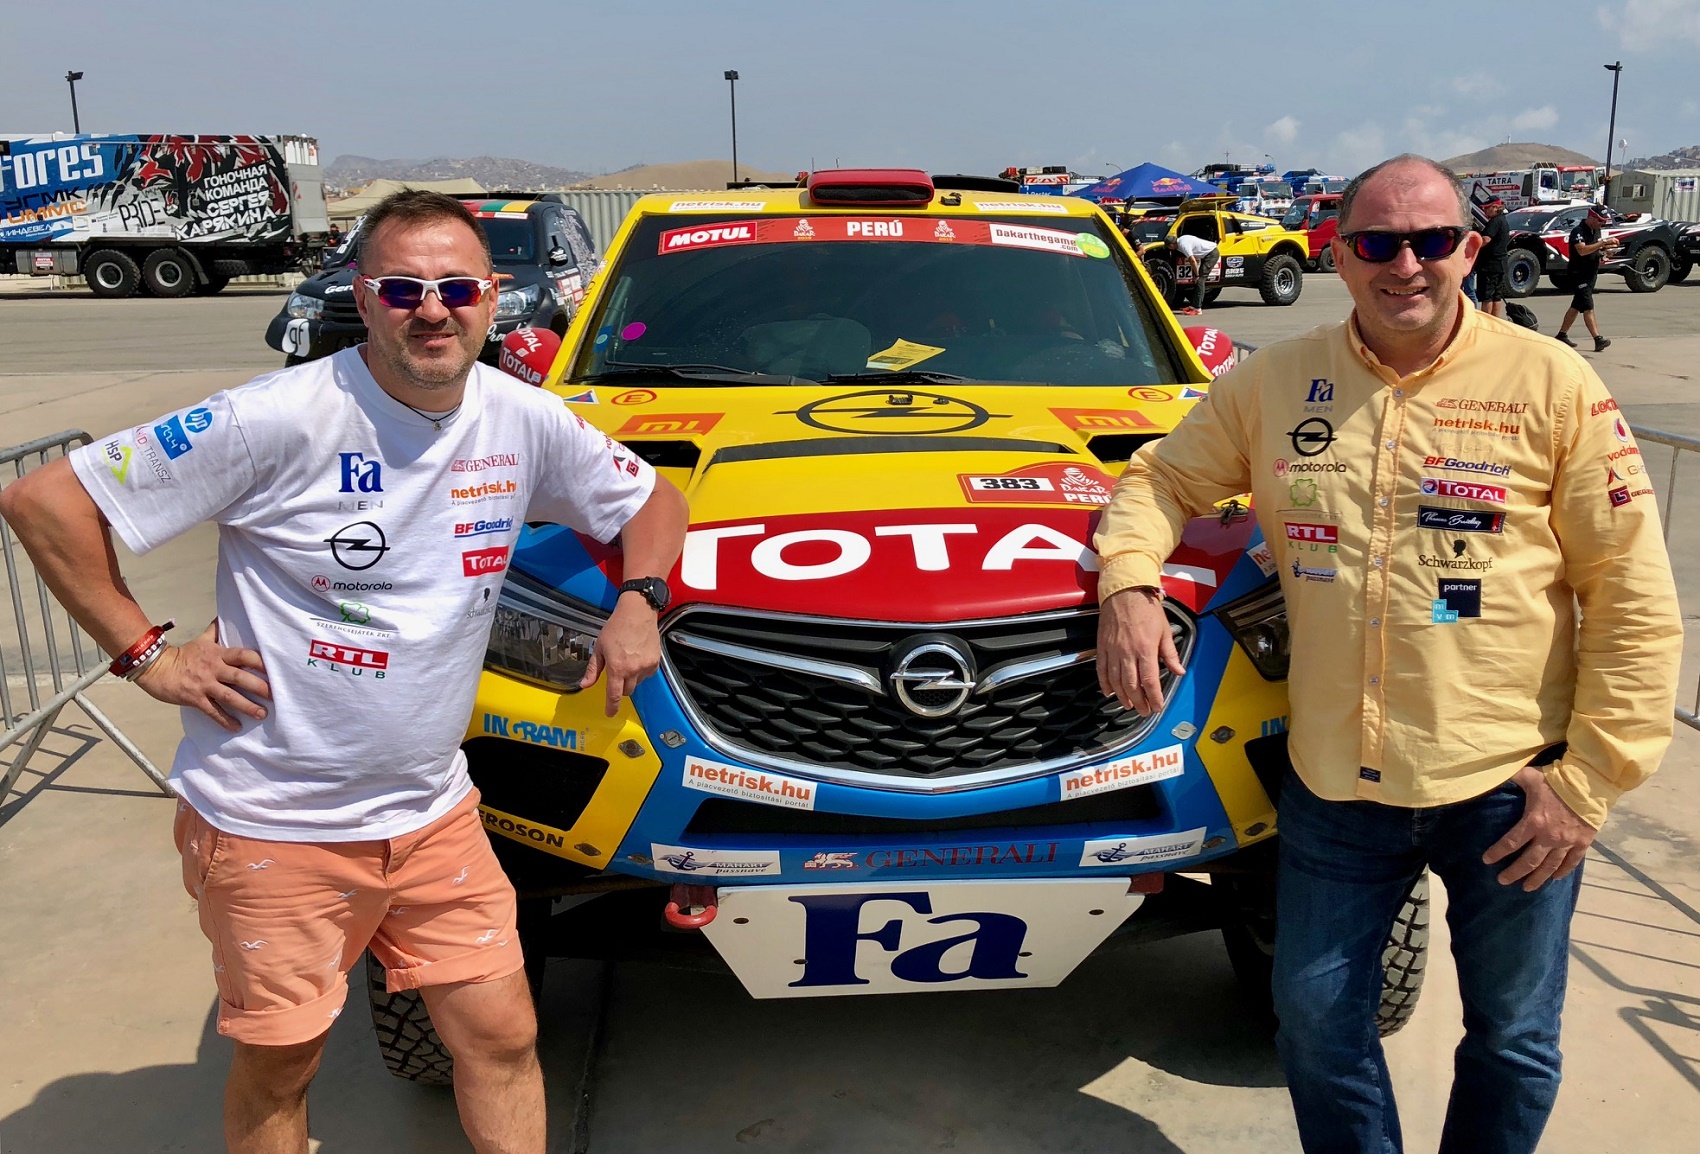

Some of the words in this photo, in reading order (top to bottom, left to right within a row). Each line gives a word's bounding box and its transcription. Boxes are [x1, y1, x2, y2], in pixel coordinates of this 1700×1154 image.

[204, 164, 268, 188] ГОНОЧНАЯ
[1487, 177, 1512, 185] TATRA
[205, 177, 268, 201] КОМАНДА
[206, 190, 269, 217] СЕРГЕЯ
[175, 207, 277, 240] КАРЯКИНА
[846, 219, 904, 236] PERÚ
[667, 226, 752, 247] MOTUL
[502, 347, 534, 383] TOTAL
[1305, 379, 1335, 403] Fa
[1303, 406, 1334, 414] MEN
[1458, 399, 1529, 414] GENERALI
[1434, 418, 1521, 435] netrisk.hu
[104, 440, 123, 462] HSP
[144, 446, 172, 483] TRANSZ
[338, 452, 384, 493] Fa
[1289, 462, 1347, 473] motorola
[1424, 456, 1512, 476] BFGoodrich
[450, 480, 517, 499] netrisk.h
[980, 478, 1041, 490] 383
[1440, 481, 1505, 502] TOTAL
[338, 500, 384, 511] MEN
[1286, 525, 1337, 541] RTL
[1288, 541, 1338, 553] KLUB
[1418, 555, 1493, 572] Schwarzkopf
[333, 581, 393, 592] motorola
[1443, 584, 1478, 592] partner
[312, 642, 386, 667] RTL
[306, 658, 386, 679] KLUB
[1066, 751, 1179, 791] netrisk.hu
[689, 763, 811, 801] netrisk.hu
[696, 782, 739, 795] piacvezető
[741, 788, 783, 804] biztosítási
[785, 798, 809, 808] portál
[866, 842, 1060, 869] GENERALI
[788, 892, 1029, 987] Fa
